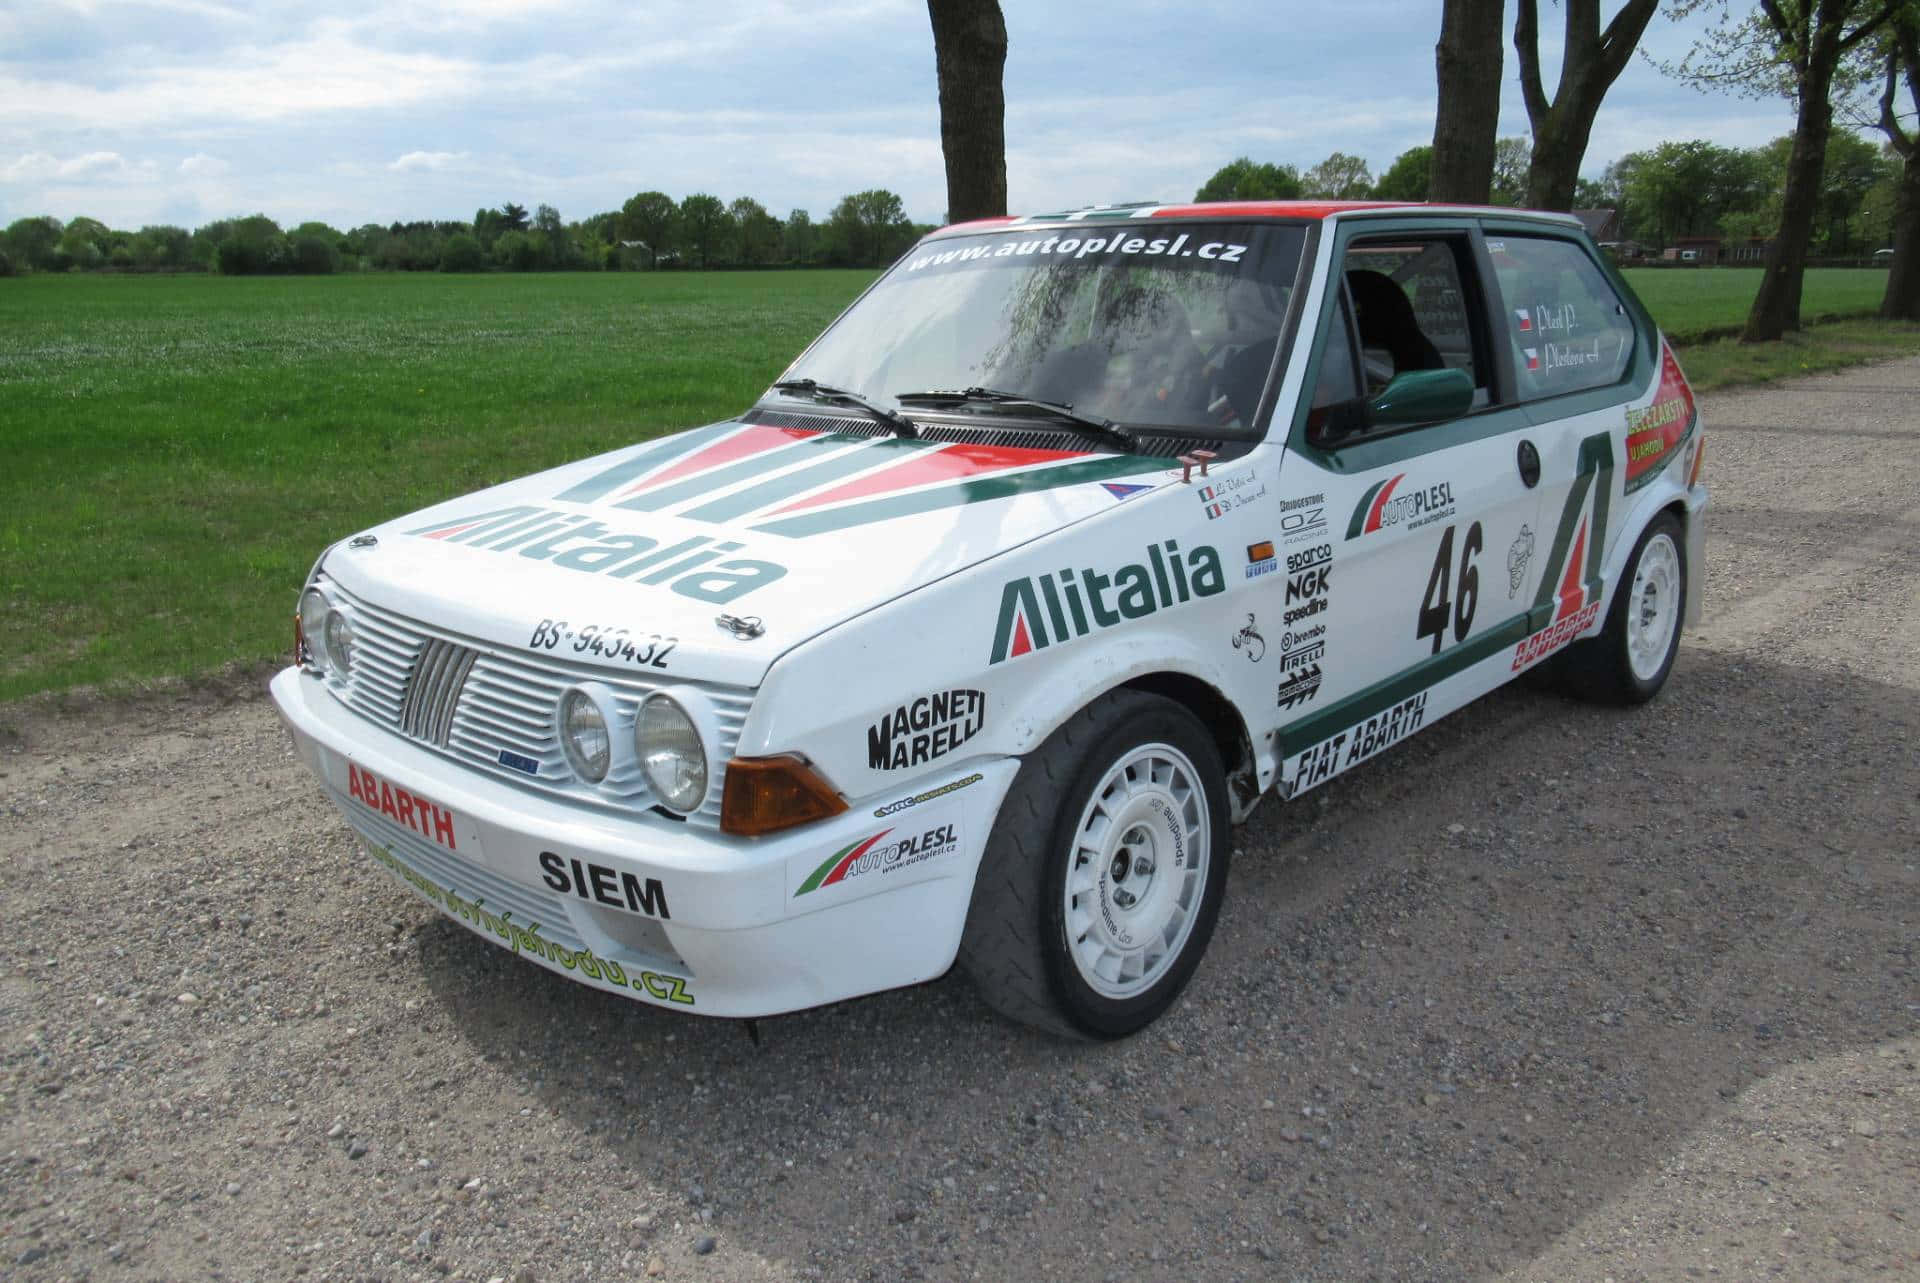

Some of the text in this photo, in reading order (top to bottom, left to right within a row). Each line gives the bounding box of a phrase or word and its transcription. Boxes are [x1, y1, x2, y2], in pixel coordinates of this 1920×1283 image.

[909, 233, 1248, 273] www.autoplesl.cz
[1280, 493, 1325, 512] BRIDGESTONE
[1281, 508, 1326, 530] OZ
[1381, 482, 1455, 527] AUTOPLESL
[401, 505, 789, 605] Alitalia
[1284, 529, 1328, 545] RACING
[1287, 544, 1332, 572] sparco
[989, 539, 1226, 665] Alitalia
[1286, 565, 1332, 606] NGK
[1416, 521, 1483, 656] 46
[1284, 598, 1328, 627] speedline
[1293, 624, 1326, 645] brembo
[1280, 640, 1325, 672] PIRELLI
[868, 689, 985, 745] MAGNETI
[868, 718, 984, 770] MARELLI
[1292, 691, 1428, 794] FIAT ABARTH
[348, 763, 457, 850] ABARTH
[841, 824, 958, 880] AUTOPLESL
[1163, 806, 1185, 867] speedline
[882, 844, 957, 875] www.autoplesl.cz
[539, 851, 671, 920] SIEM
